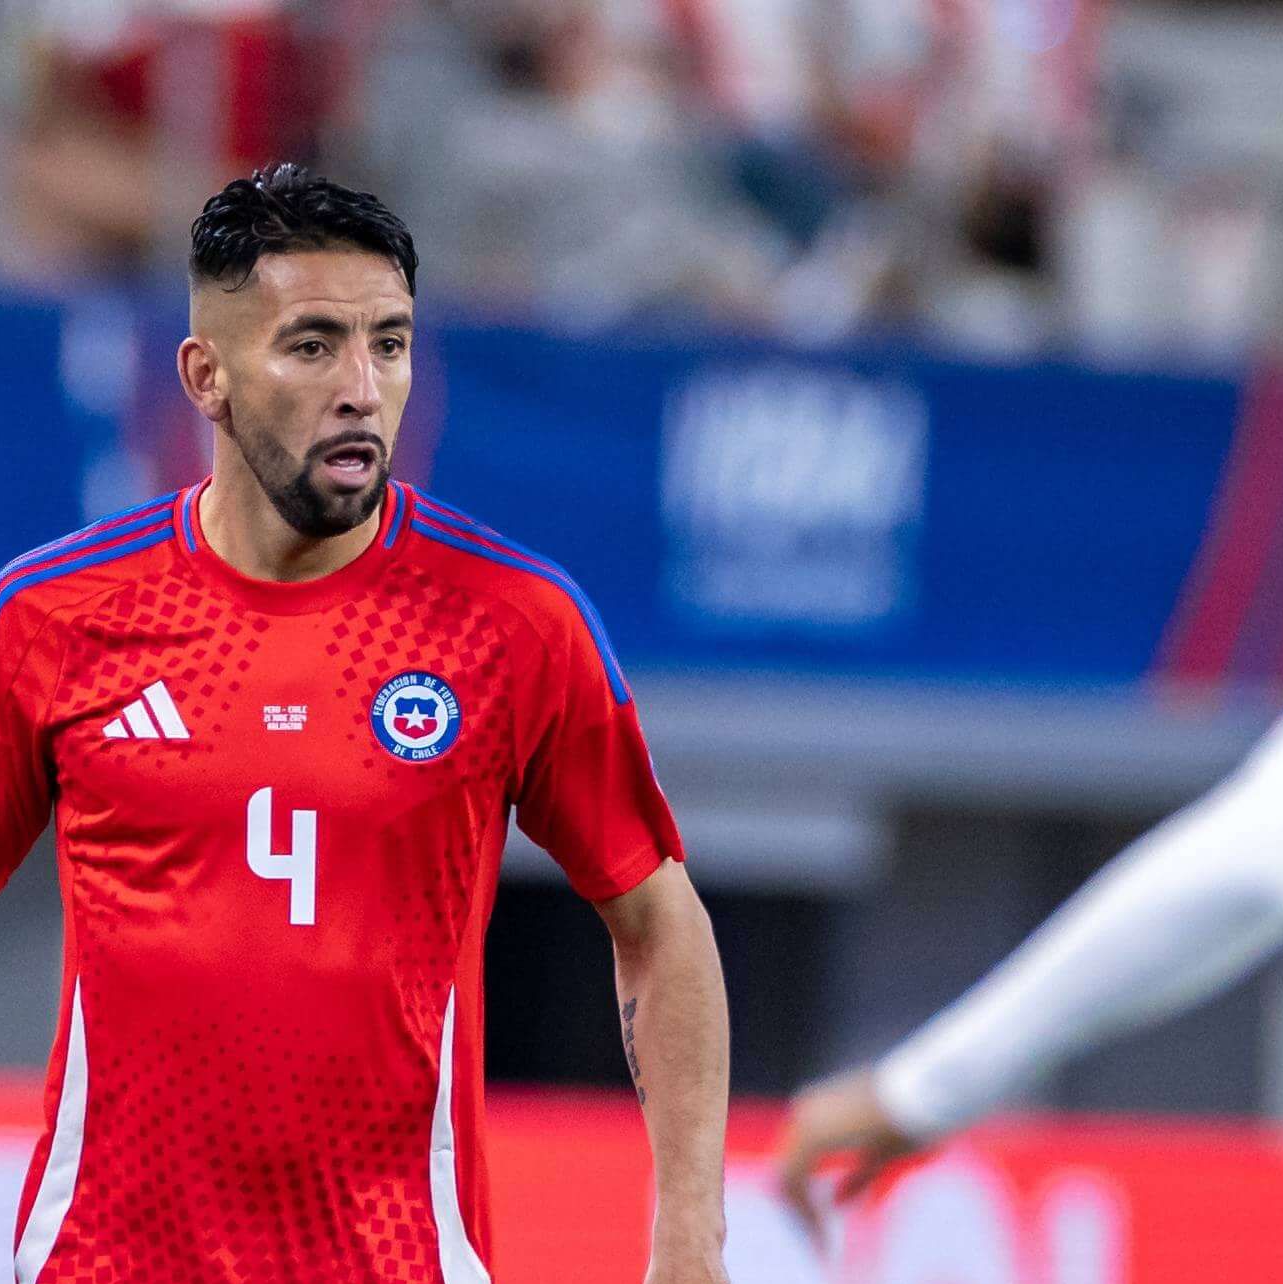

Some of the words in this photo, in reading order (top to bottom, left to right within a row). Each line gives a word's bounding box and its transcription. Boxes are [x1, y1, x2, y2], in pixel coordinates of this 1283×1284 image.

[372, 674, 418, 716] FEDERACION
[424, 676, 437, 688] DE
[438, 686, 459, 720] FUTBOL
[392, 743, 406, 757] DE
[412, 745, 439, 759] CHILE
[246, 786, 318, 926] 4
